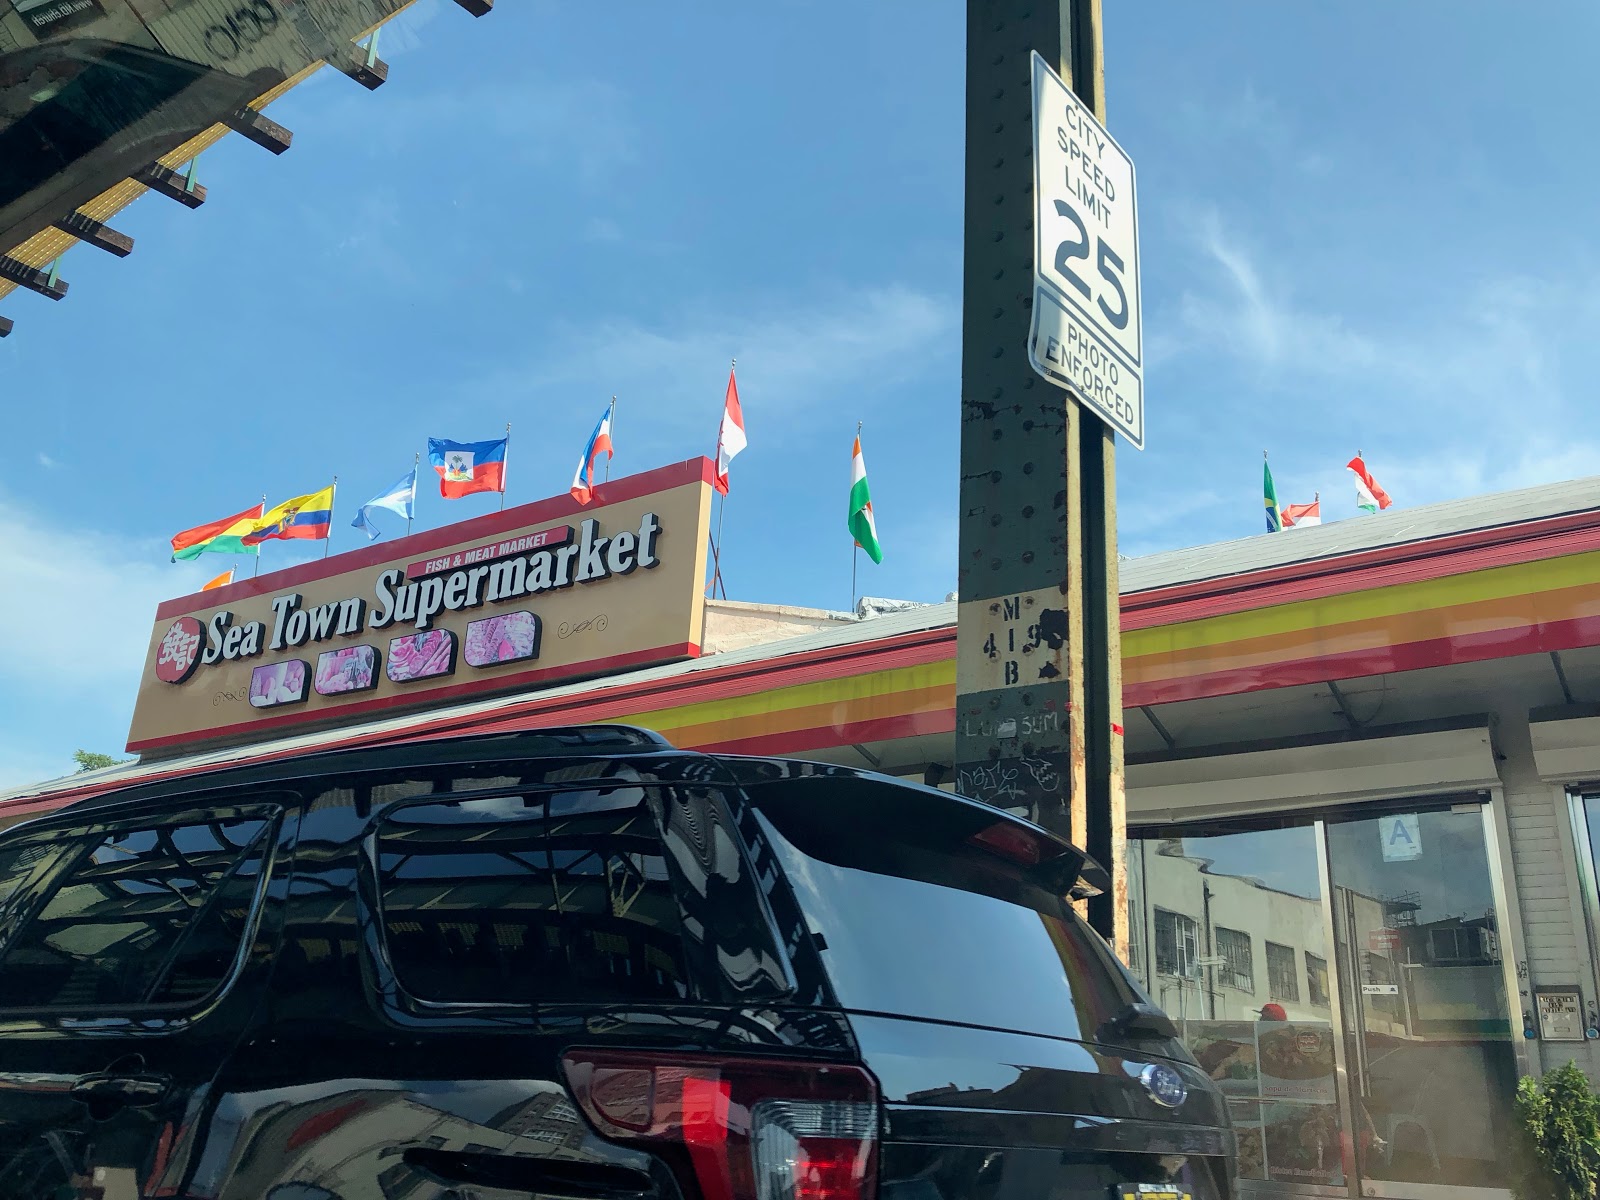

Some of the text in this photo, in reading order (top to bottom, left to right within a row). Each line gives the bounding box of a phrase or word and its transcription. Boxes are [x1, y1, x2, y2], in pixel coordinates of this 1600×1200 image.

[1057, 126, 1116, 202] SPEED
[1065, 104, 1105, 160] CITY
[1065, 165, 1112, 229] LIMIT
[1053, 199, 1129, 331] 25
[1045, 335, 1134, 425] ENFORCED
[1067, 322, 1119, 386] PHOTO
[425, 532, 548, 574] FISH & MEAT MARKET
[201, 512, 659, 665] Sea Town Supermarket
[1003, 596, 1021, 622] M
[1005, 660, 1019, 686] B
[1389, 819, 1414, 846] A
